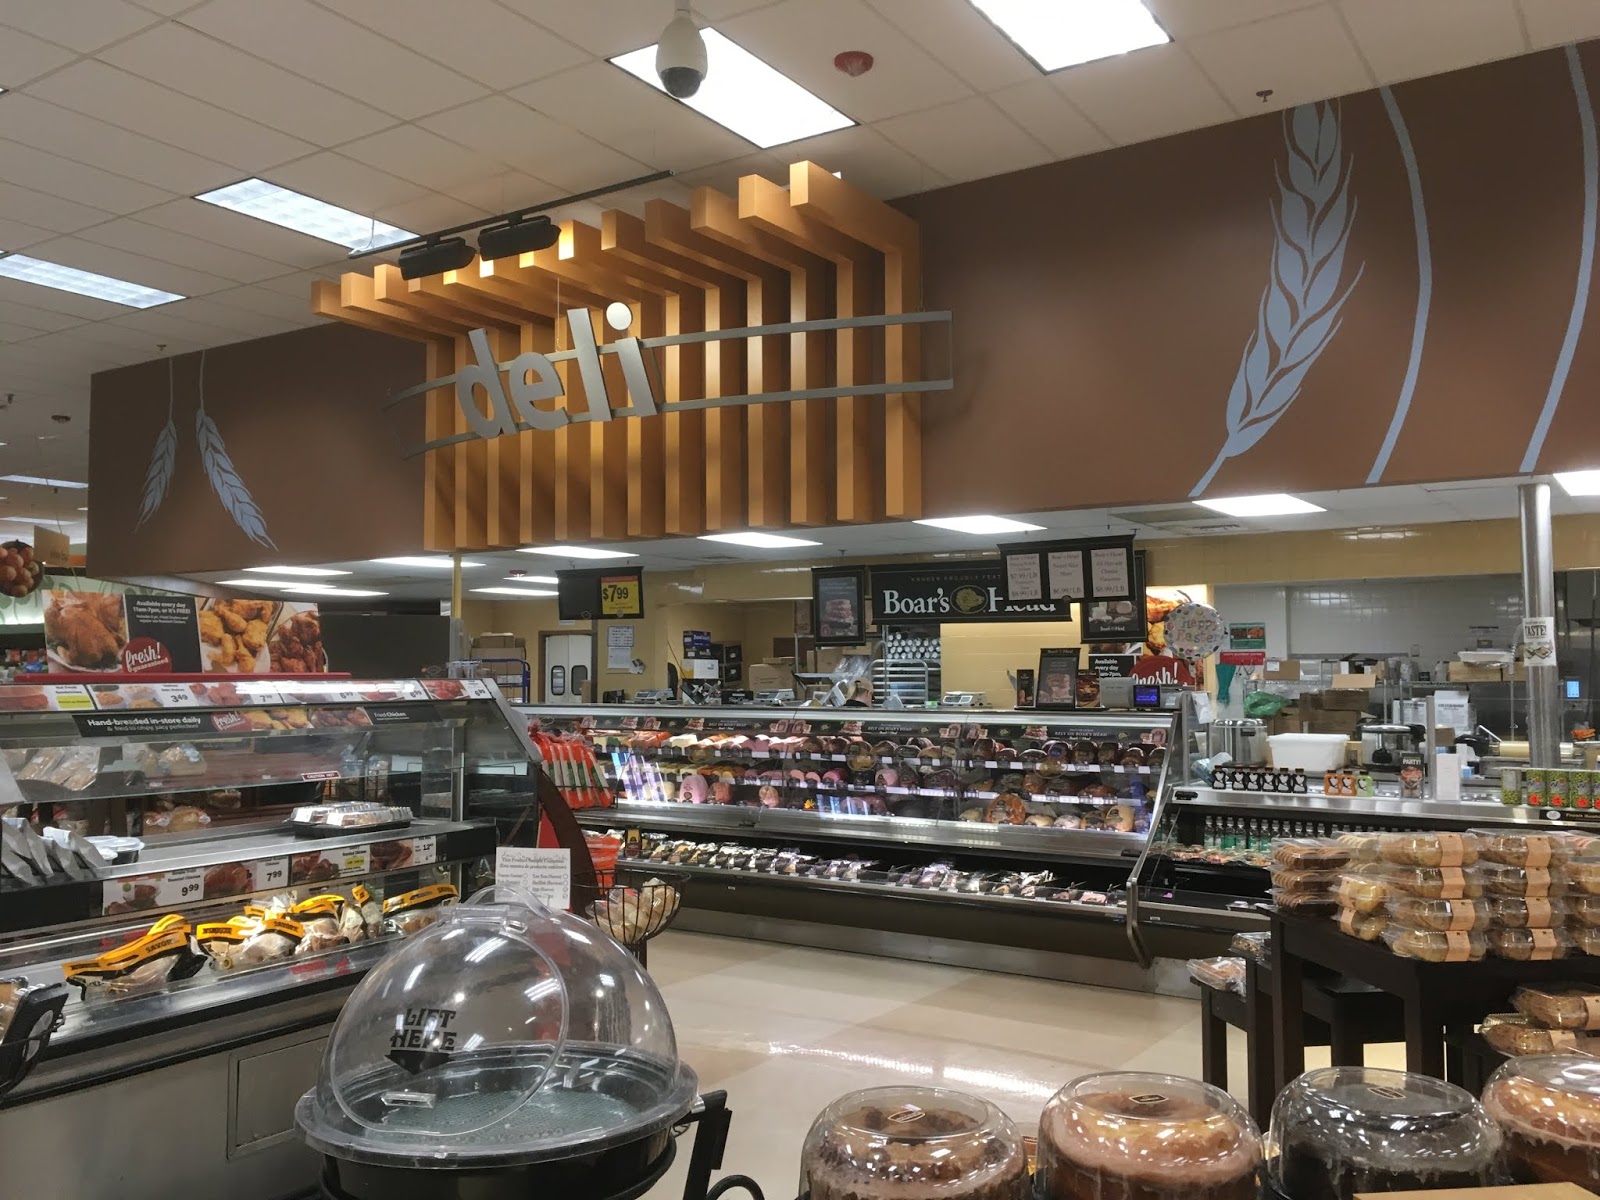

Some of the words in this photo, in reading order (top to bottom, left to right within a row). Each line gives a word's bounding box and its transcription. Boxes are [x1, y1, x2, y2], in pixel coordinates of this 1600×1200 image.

[457, 302, 657, 439] deli
[883, 587, 950, 614] Boar's
[126, 641, 161, 672] fresh!
[131, 657, 169, 673] guaranteed
[87, 717, 149, 726] Hand-breaded
[149, 717, 181, 725] in-store
[182, 716, 201, 724] daily
[266, 869, 282, 881] 799
[181, 883, 199, 897] 999
[405, 1008, 457, 1028] LIFT
